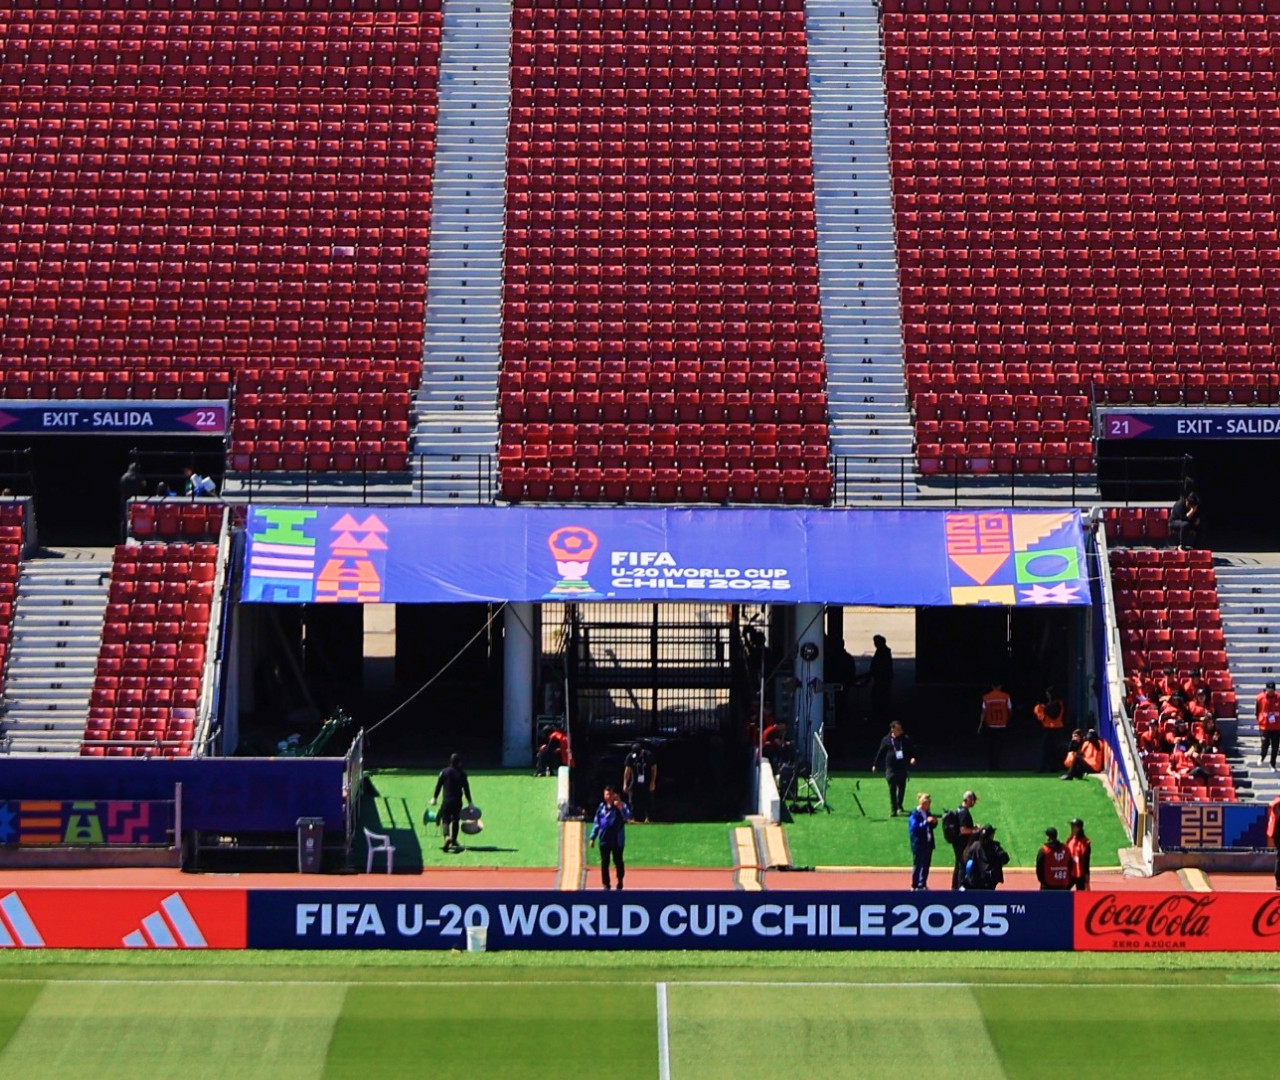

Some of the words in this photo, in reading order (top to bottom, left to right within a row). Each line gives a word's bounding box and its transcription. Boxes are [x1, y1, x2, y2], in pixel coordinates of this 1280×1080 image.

[860, 357, 874, 365] AA
[453, 394, 465, 402] AC
[862, 395, 875, 403] AC
[44, 413, 78, 425] EXIT
[93, 412, 153, 425] SALIDA
[197, 412, 215, 425] 22
[1112, 421, 1128, 433] 21
[1178, 420, 1212, 433] EXIT
[612, 552, 676, 566] FIFA
[612, 568, 659, 579] U-20
[663, 568, 740, 580] WORLD
[745, 569, 787, 578] CUP
[612, 578, 705, 588] CHILE
[709, 579, 790, 589] 2025
[297, 904, 385, 934] FIFA
[398, 904, 489, 936] U-20
[499, 904, 649, 935] WORLD
[660, 905, 742, 935] CUP
[752, 905, 885, 935] CHILE
[1085, 894, 1215, 936] Coca-Cola
[1144, 941, 1186, 949] AZÚCAR
